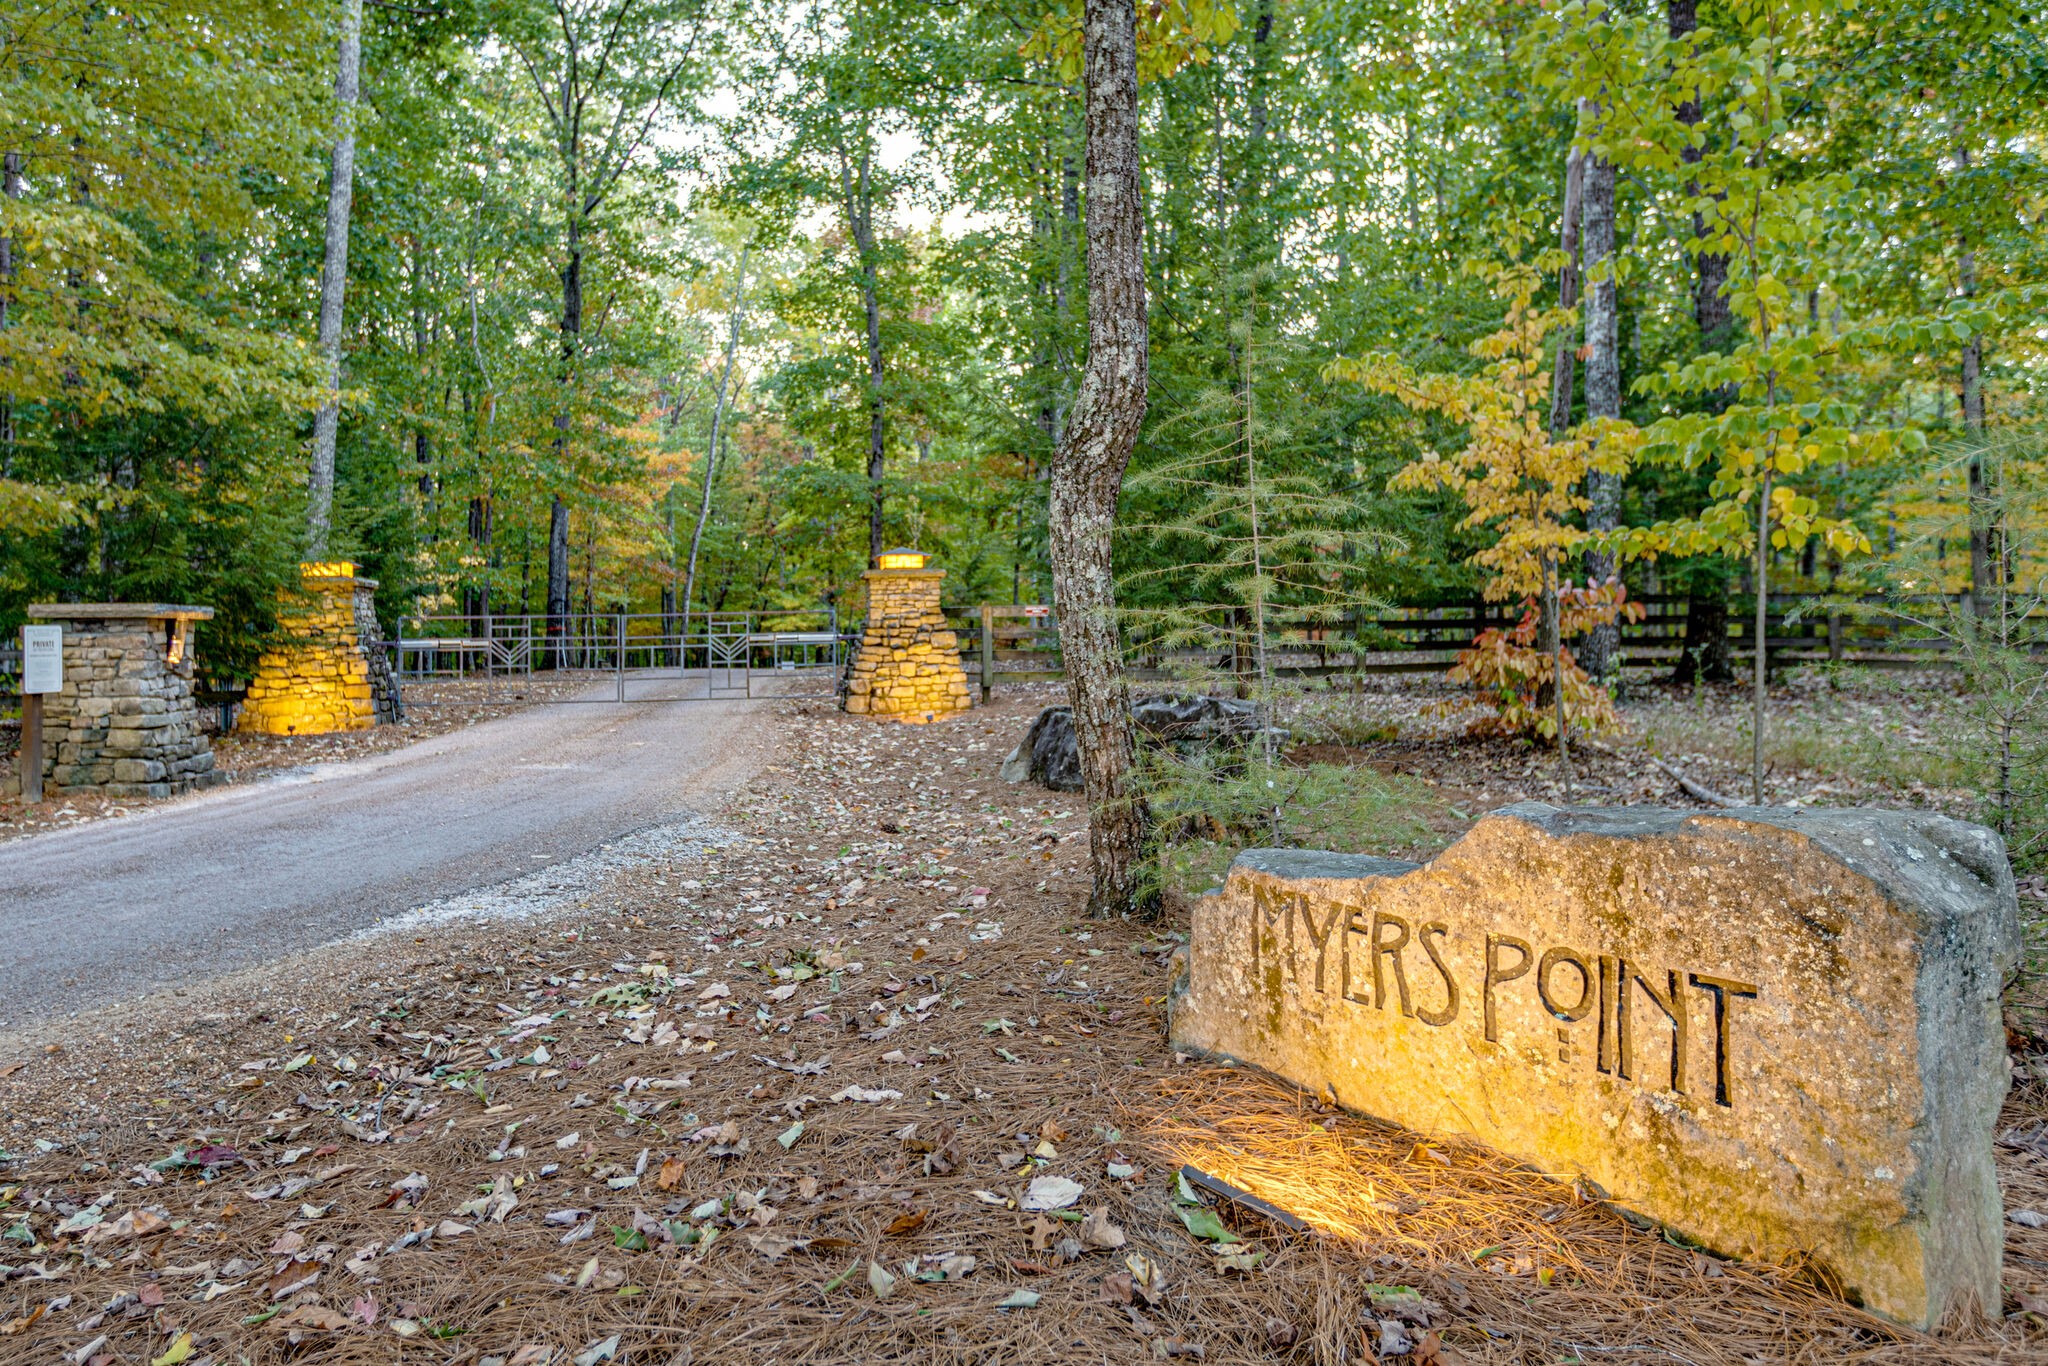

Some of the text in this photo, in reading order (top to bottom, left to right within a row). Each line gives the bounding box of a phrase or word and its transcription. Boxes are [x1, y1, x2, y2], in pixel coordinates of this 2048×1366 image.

[32, 640, 55, 648] PRIVATE
[1252, 884, 1758, 1108] MYERS POINT
